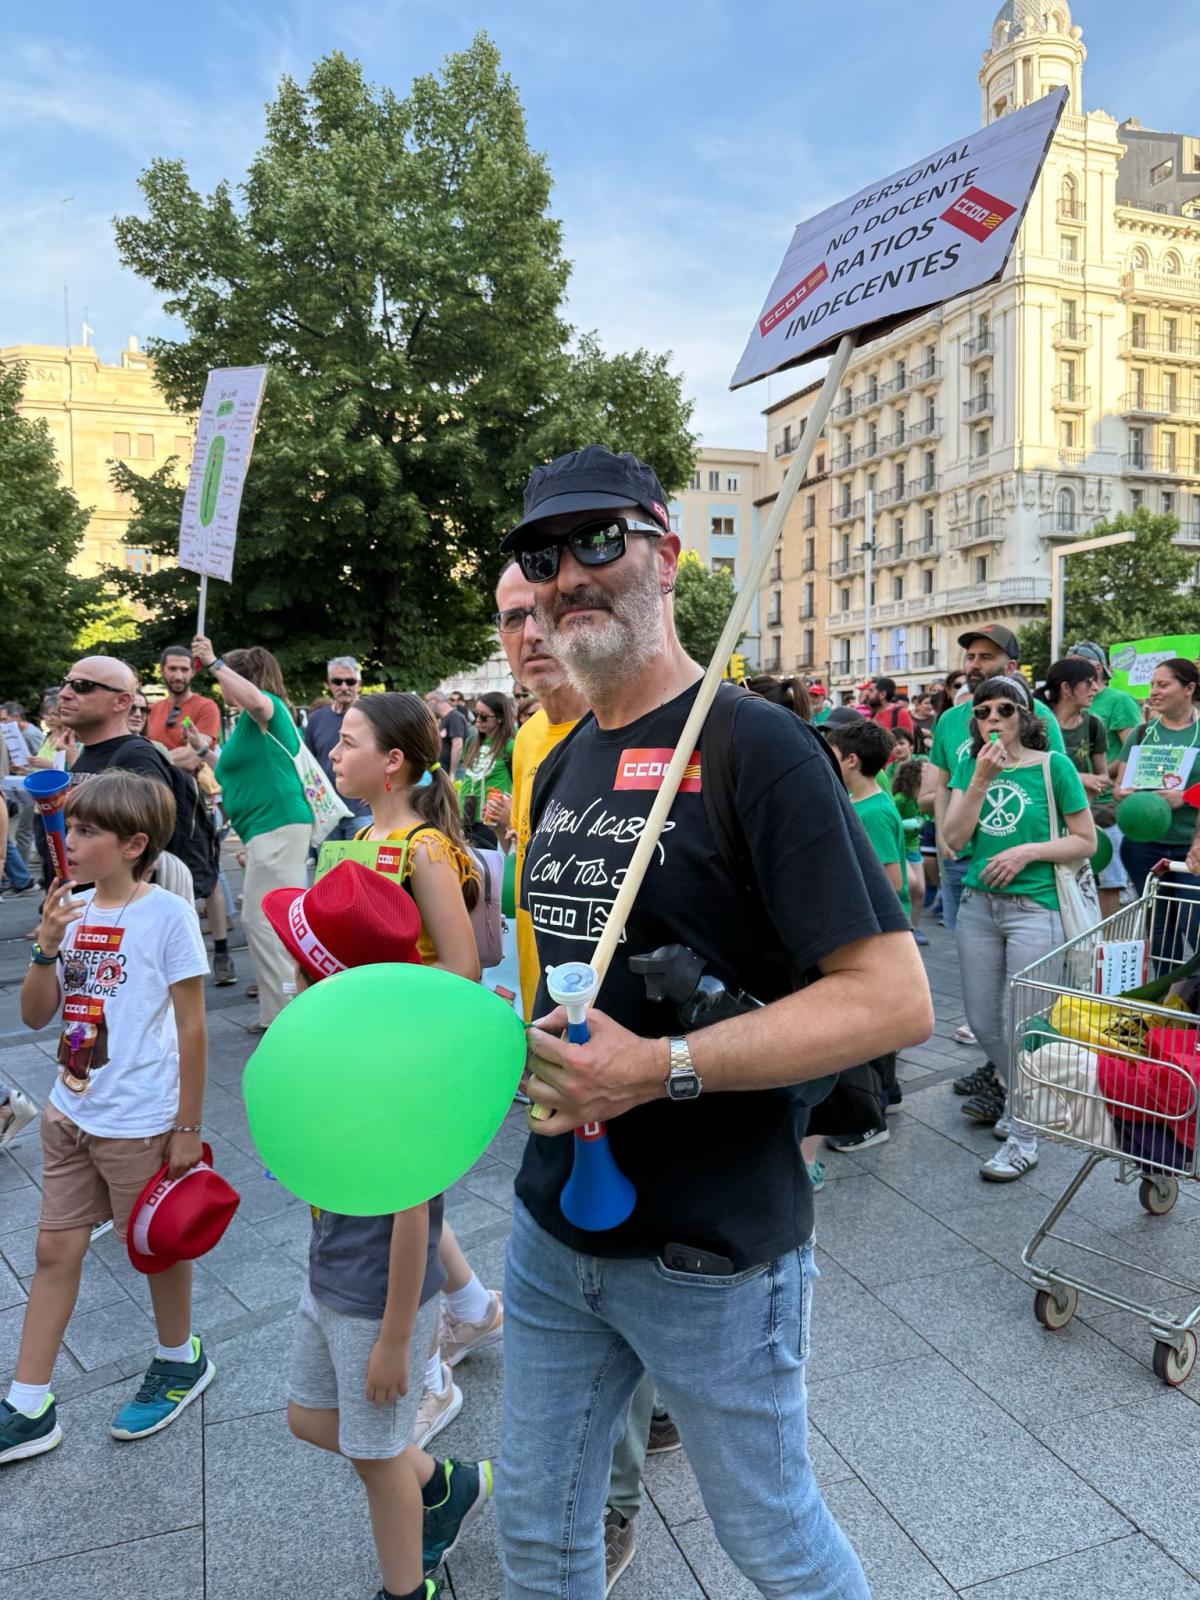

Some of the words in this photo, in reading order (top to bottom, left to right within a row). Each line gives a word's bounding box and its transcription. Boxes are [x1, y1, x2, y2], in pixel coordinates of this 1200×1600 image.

[850, 143, 970, 217] PERSONAL
[826, 224, 858, 255] NO
[862, 166, 980, 235] DOCENTE
[951, 198, 988, 224] CCOO
[829, 216, 938, 284] RATIOS
[763, 286, 808, 328] CCOO
[784, 242, 962, 341] INDECENTES
[530, 852, 576, 885] CON
[533, 903, 577, 929] CCOO
